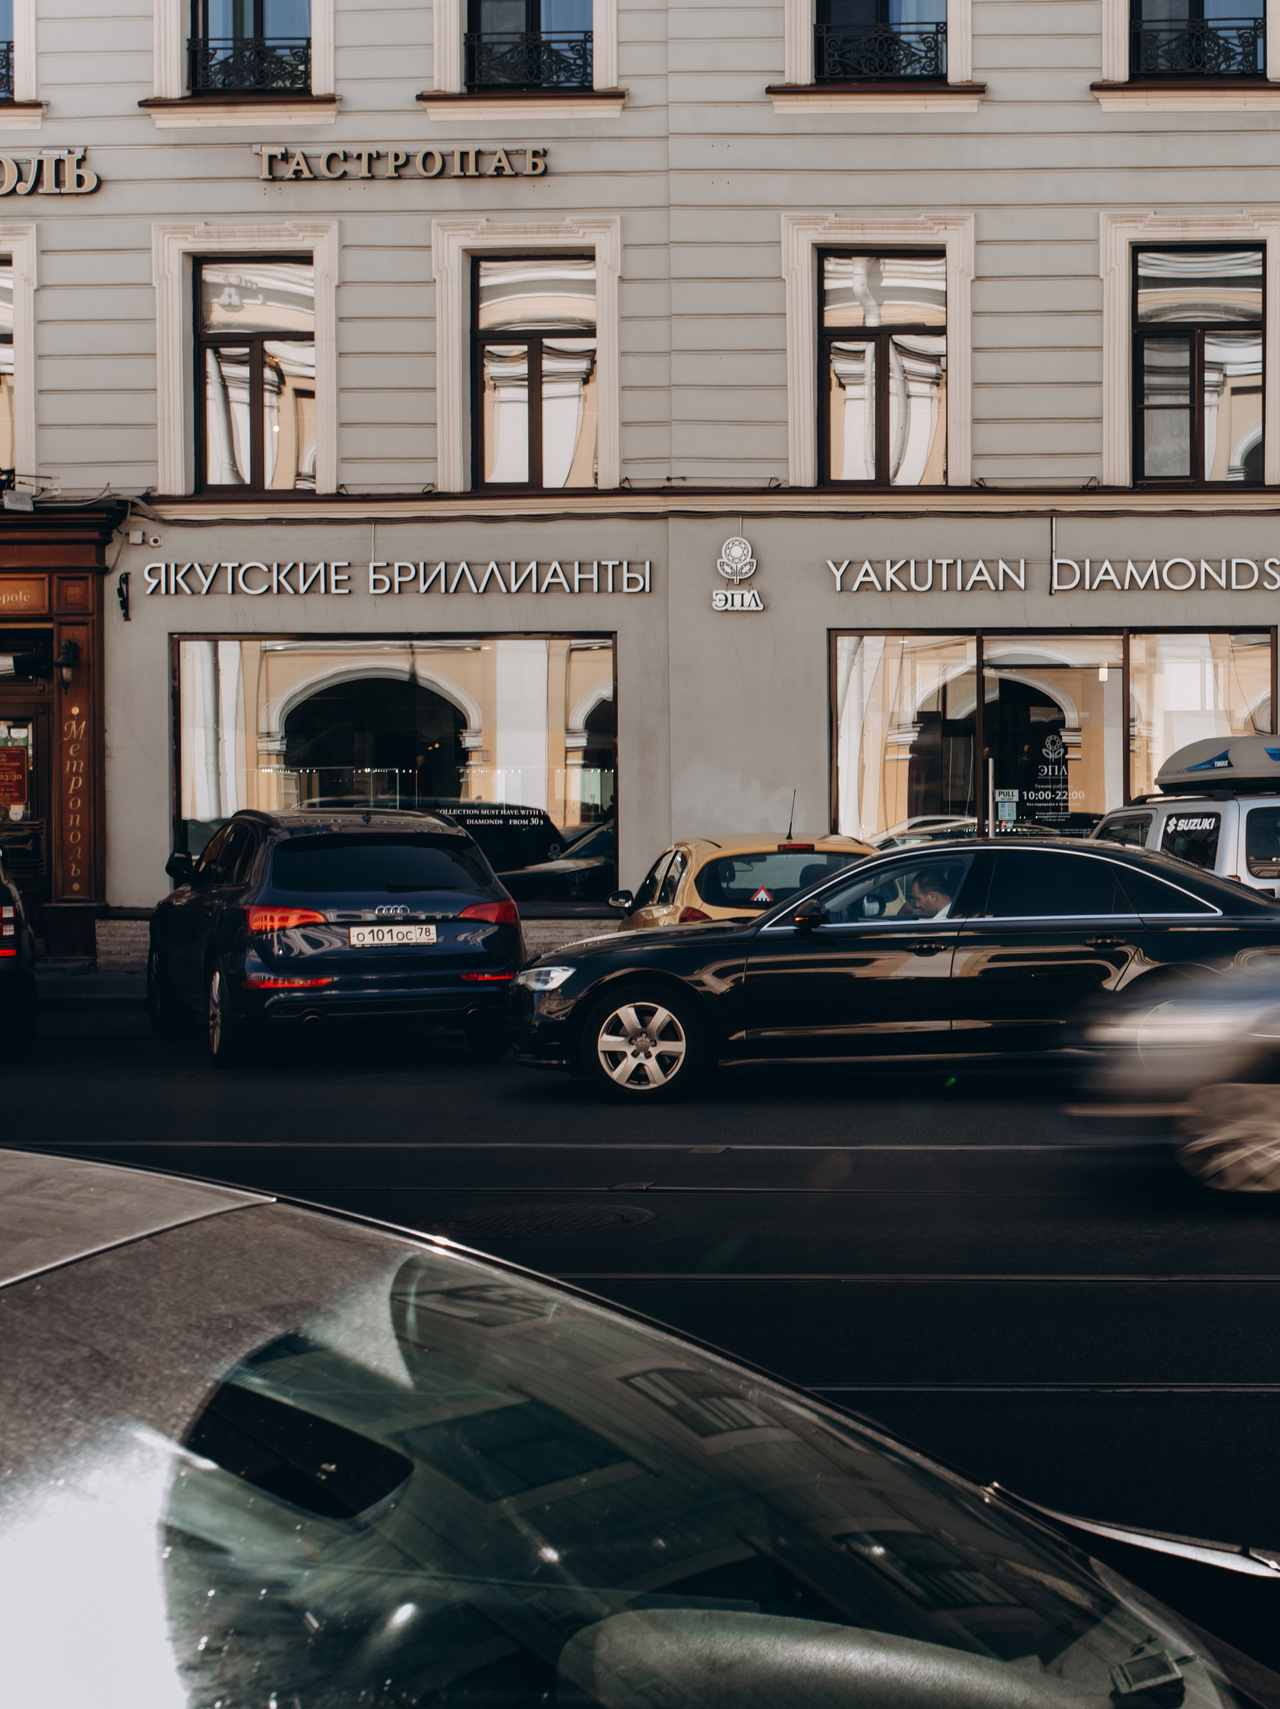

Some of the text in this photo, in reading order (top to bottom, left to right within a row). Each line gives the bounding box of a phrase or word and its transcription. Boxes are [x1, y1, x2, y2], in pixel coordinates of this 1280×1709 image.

[259, 148, 548, 180] ГАСТРОПАБ
[143, 560, 652, 595] ЯКУТСКИЕ БРИЛЛИАНТЫ
[826, 558, 1026, 592] YAKUTIAN
[0, 590, 31, 605] pole
[712, 590, 764, 611] ЭПЛ
[1214, 759, 1229, 768] THULE
[63, 720, 87, 877] Метрополь
[1022, 791, 1085, 800] 10:00-22:00
[1176, 818, 1216, 831] SUZUKI
[417, 927, 431, 937] 78
